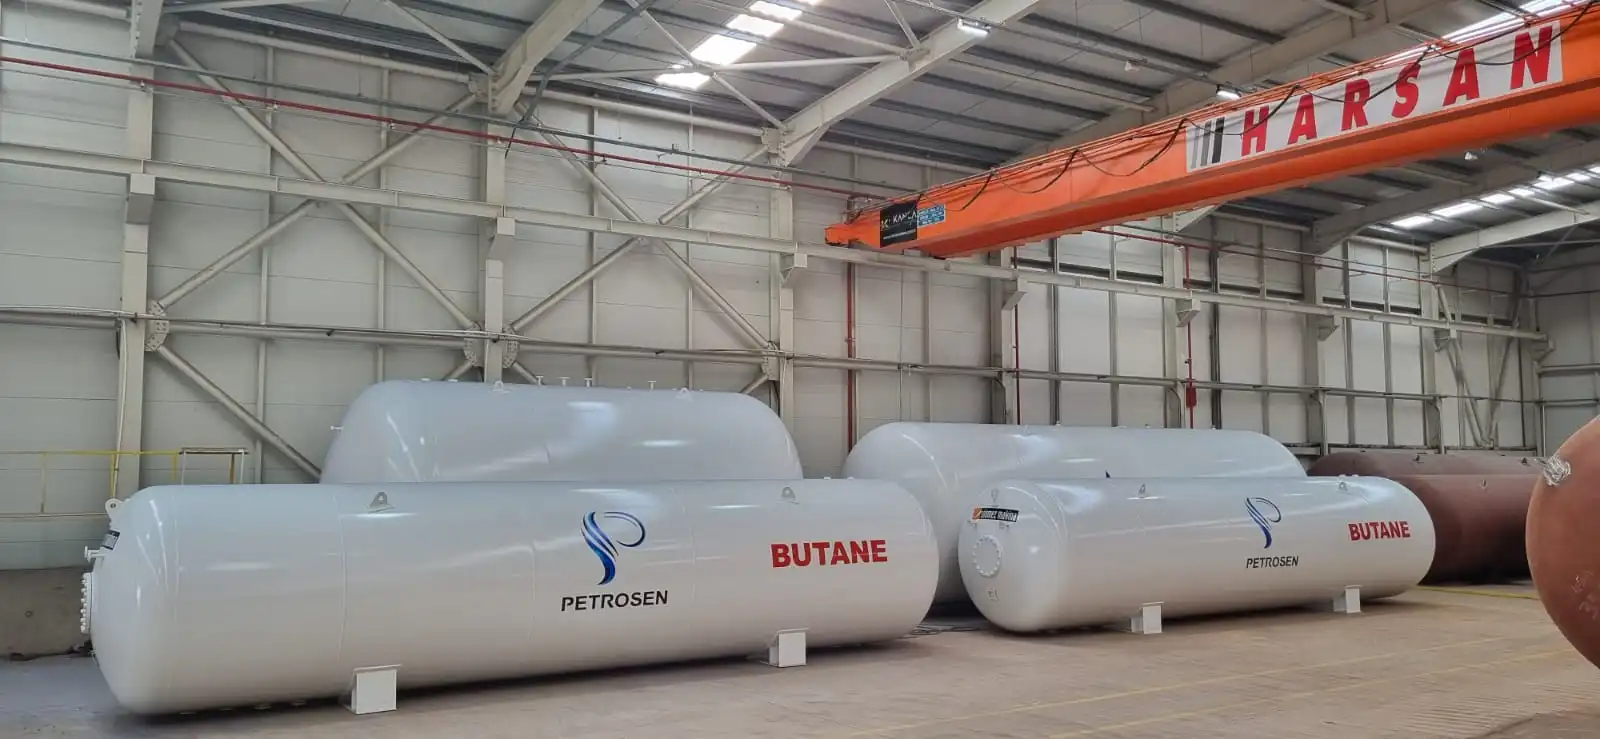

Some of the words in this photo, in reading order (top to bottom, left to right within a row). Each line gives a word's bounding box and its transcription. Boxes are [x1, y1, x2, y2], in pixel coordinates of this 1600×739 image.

[1241, 26, 1552, 156] HARSAN
[1349, 521, 1411, 541] BUTANE
[771, 540, 888, 568] BUTANE
[1246, 556, 1299, 568] PETROSEN
[561, 590, 668, 611] PETROSEN
